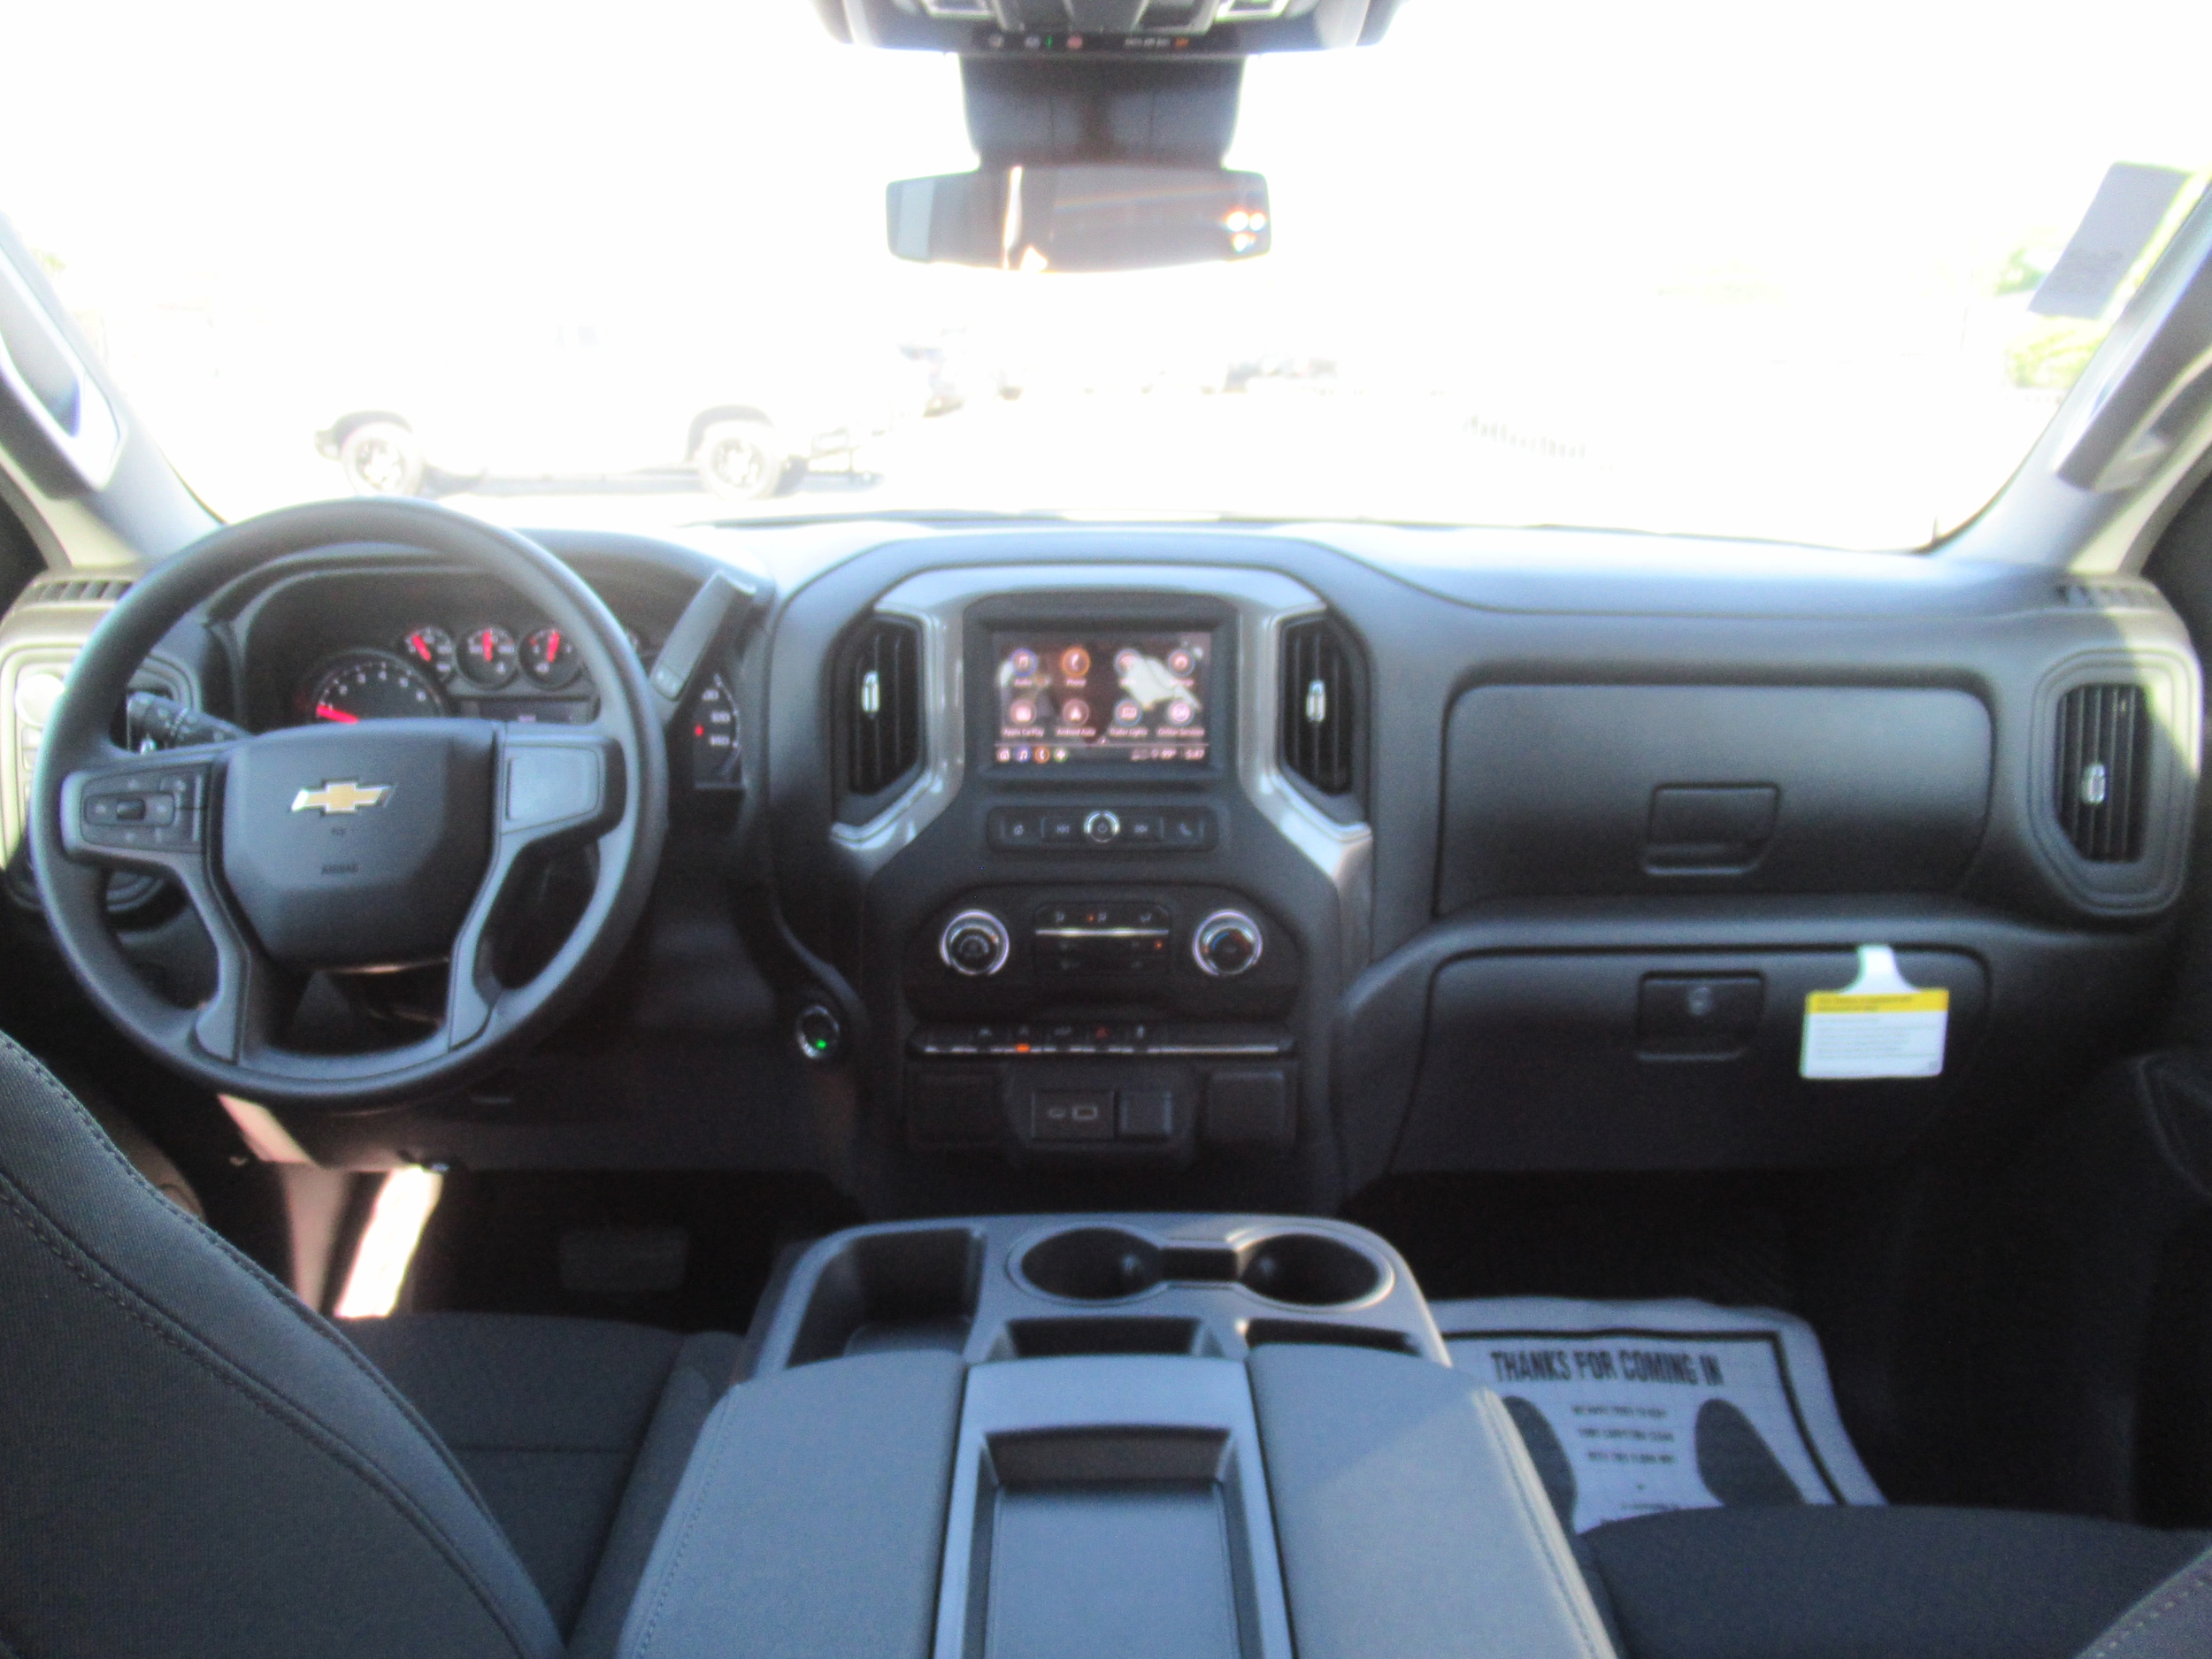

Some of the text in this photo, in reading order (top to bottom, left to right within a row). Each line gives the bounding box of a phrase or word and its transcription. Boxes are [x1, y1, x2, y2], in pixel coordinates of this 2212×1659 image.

[1491, 1349, 1724, 1386] THANKS FOR COMING IN
